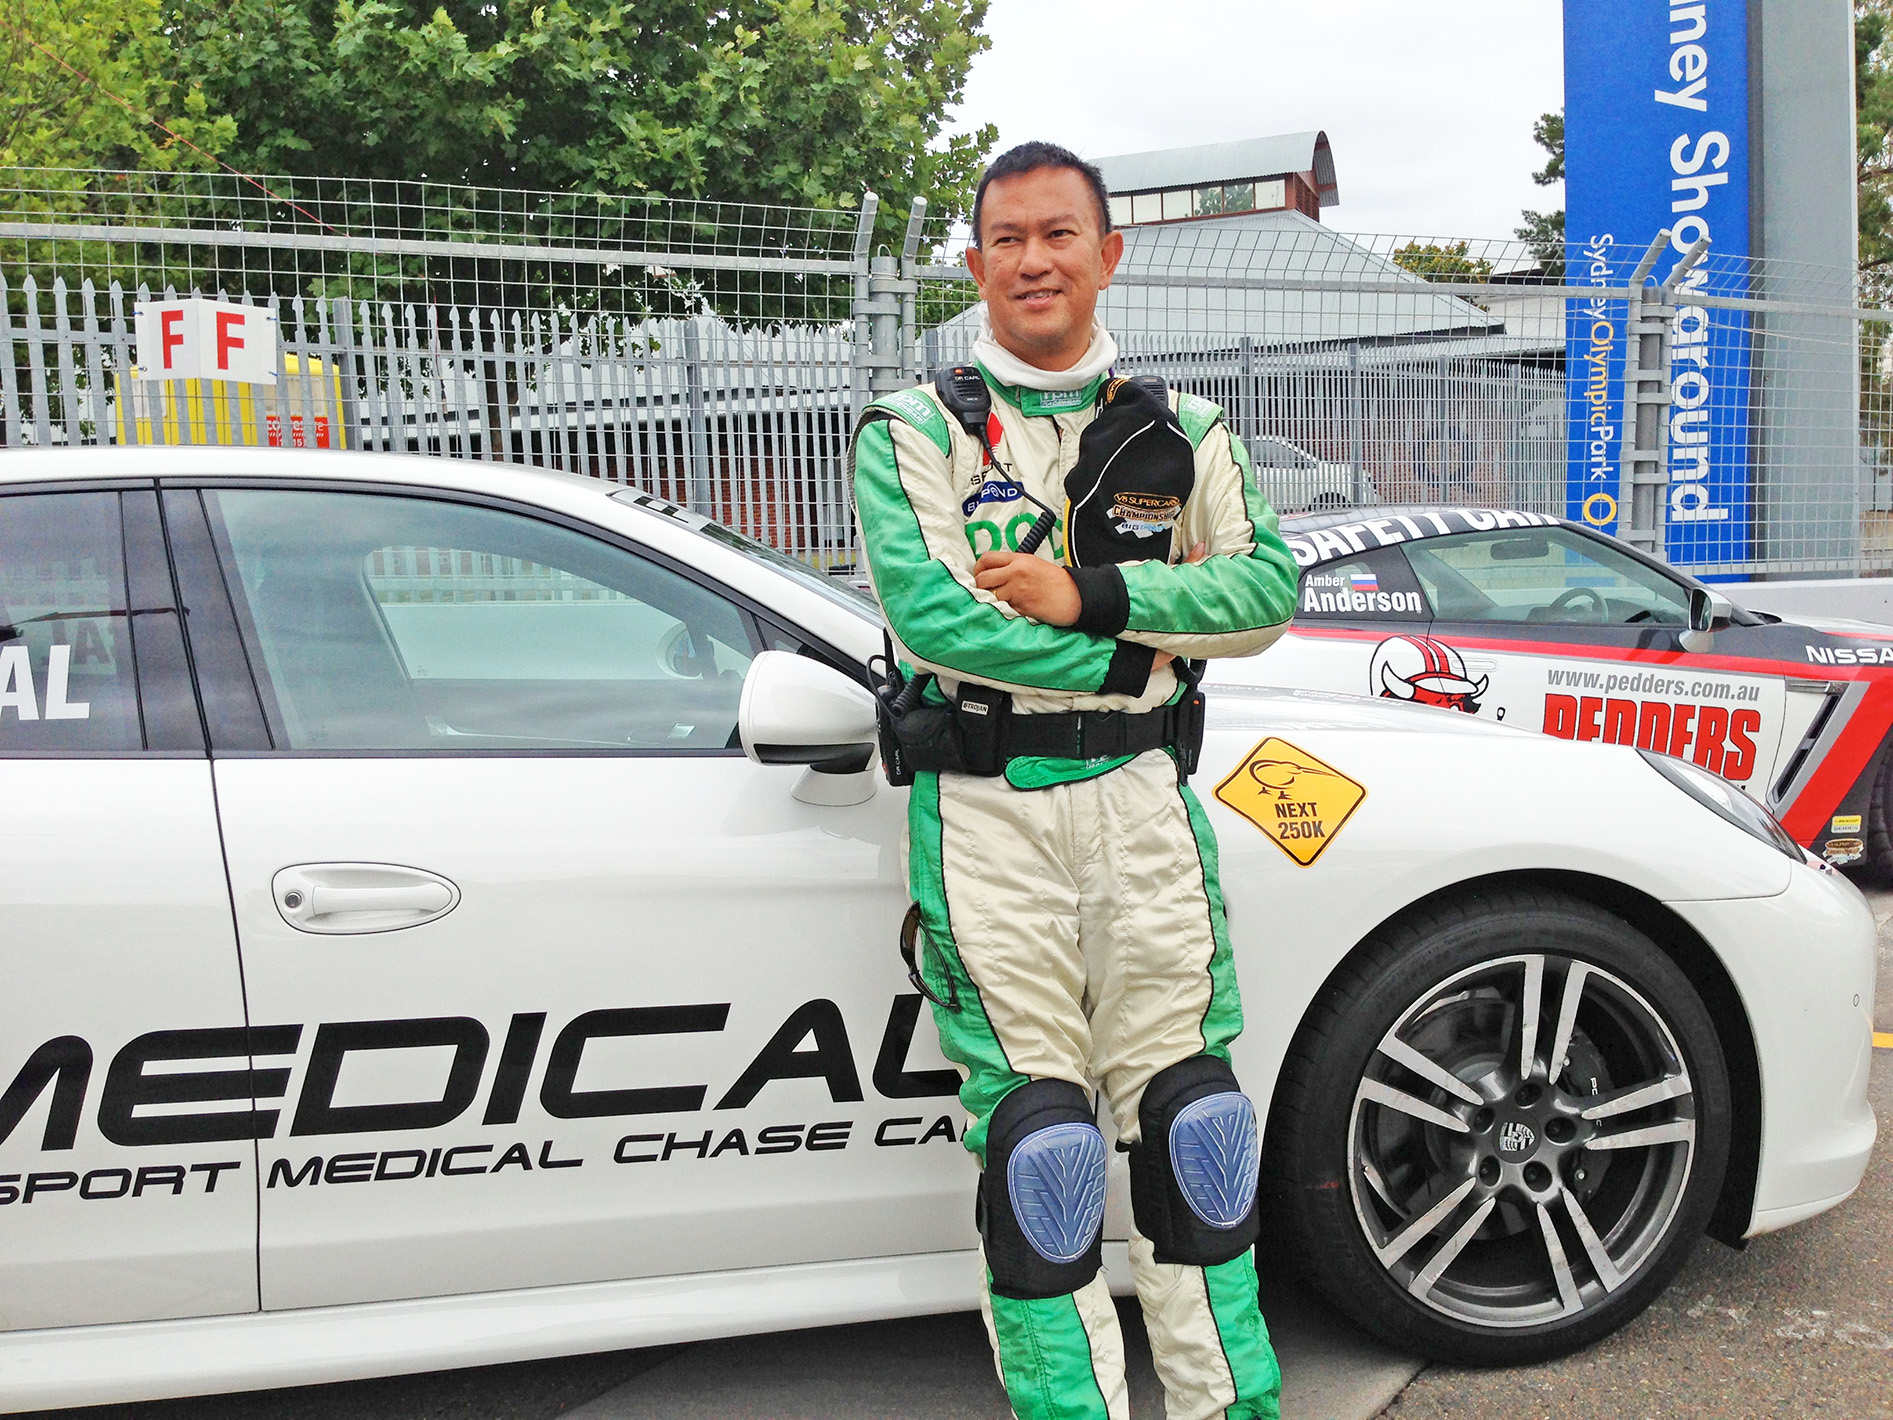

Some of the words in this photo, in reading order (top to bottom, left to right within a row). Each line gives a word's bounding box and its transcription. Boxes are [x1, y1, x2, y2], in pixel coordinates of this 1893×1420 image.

[1654, 0, 1708, 112] ney
[161, 310, 184, 369] F
[216, 311, 245, 370] F
[1283, 512, 1451, 567] SAFETY
[1452, 508, 1560, 531] CAR
[1305, 573, 1345, 587] Amber
[1303, 587, 1422, 613] Anderson
[1547, 669, 1760, 702] www.pedders.com.au
[1274, 802, 1318, 818] NEXT
[1278, 820, 1326, 840] 250K
[266, 1140, 584, 1189] MEDICAL
[613, 1121, 854, 1164] CHASE
[874, 1115, 967, 1147] CA
